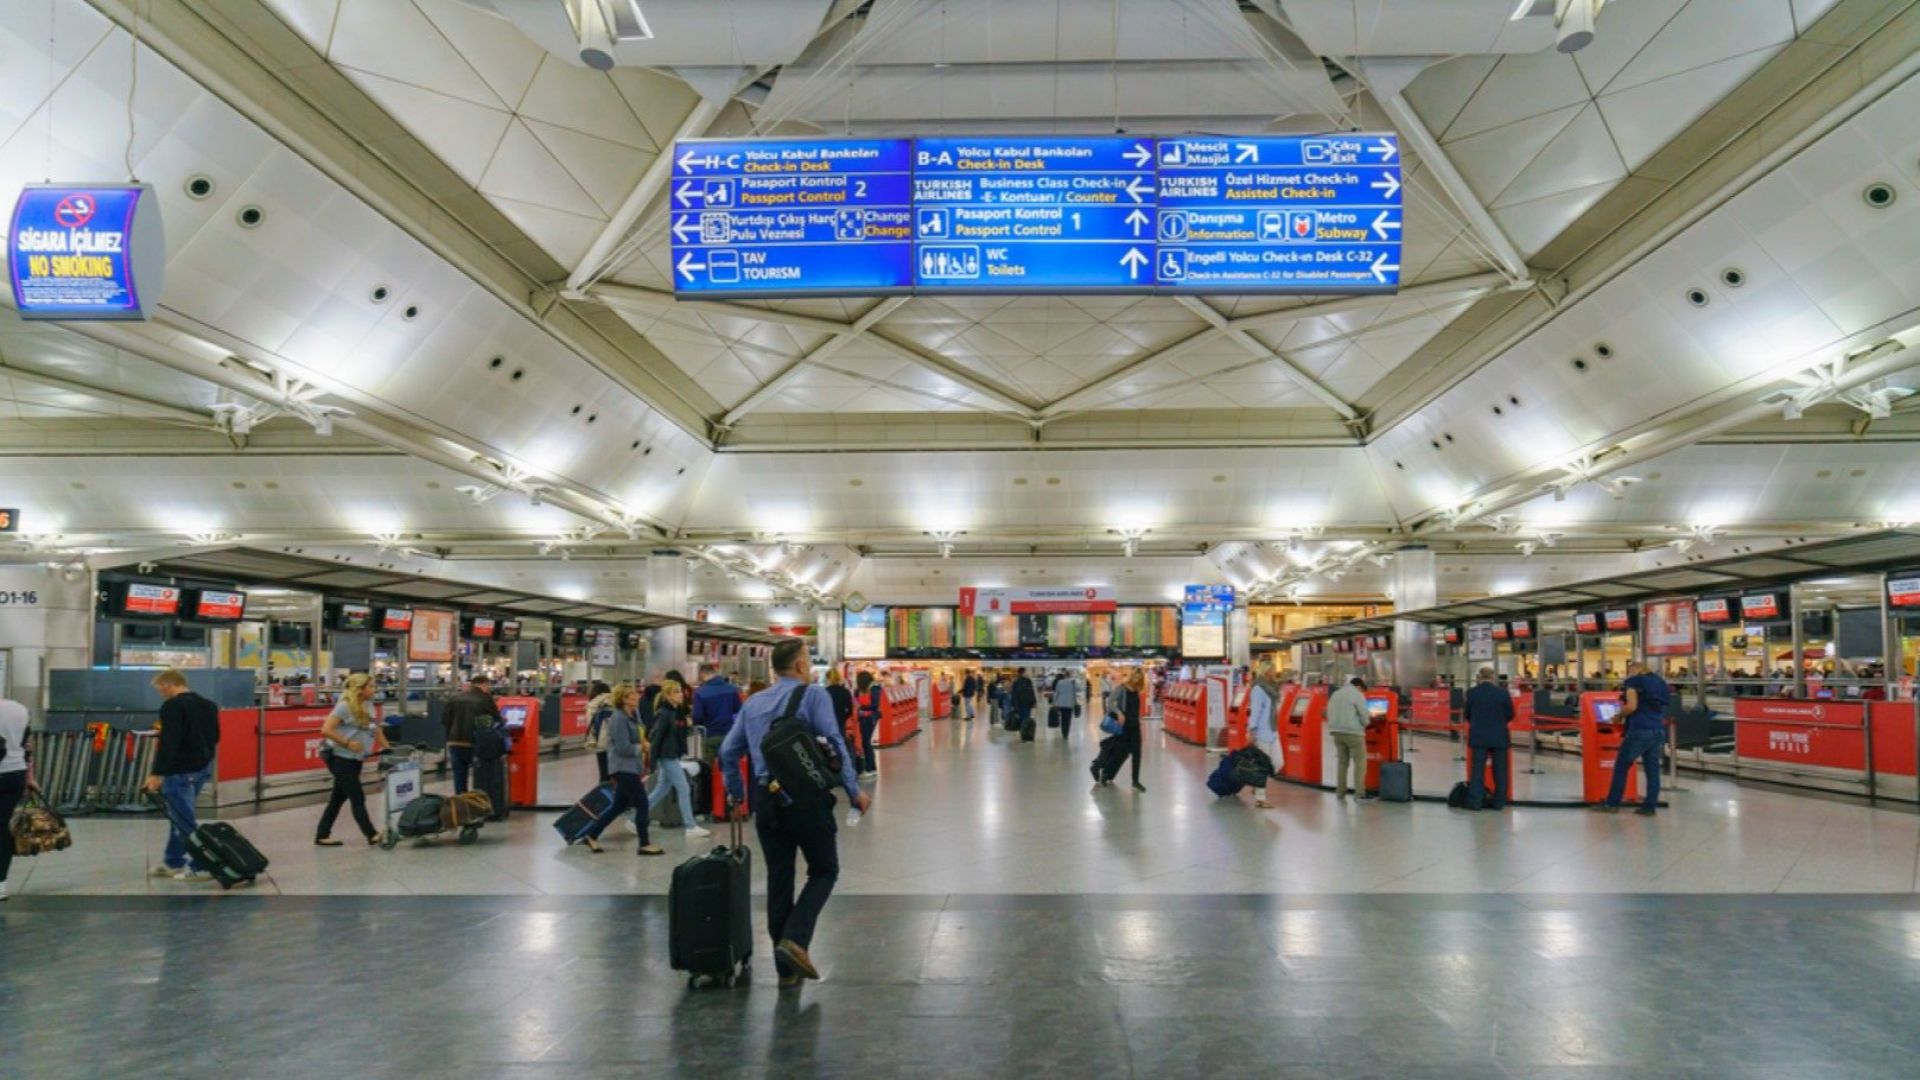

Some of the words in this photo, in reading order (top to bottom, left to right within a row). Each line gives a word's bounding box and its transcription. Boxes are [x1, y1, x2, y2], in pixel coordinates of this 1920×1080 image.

[957, 147, 990, 157] Yolcu
[995, 147, 1030, 157] Kabul
[1187, 142, 1228, 152] Mescit
[745, 151, 778, 160] Yolcu
[782, 149, 817, 159] Kabul
[918, 152, 952, 165] B-A
[1187, 153, 1229, 164] Masjid
[1332, 153, 1357, 163] Exit
[705, 155, 740, 169] H-C
[744, 162, 797, 172] Check-in
[801, 161, 831, 171] Desk
[957, 159, 1011, 169] Check-in
[1015, 158, 1045, 168] Desk
[742, 178, 796, 190] Pasaport
[800, 176, 847, 187] Kontrol
[980, 178, 1034, 189] Business
[1037, 177, 1069, 188] Class
[1072, 177, 1127, 188] Check-in
[1160, 177, 1217, 187] TURKISH
[1225, 172, 1253, 184] Özel
[1256, 173, 1300, 184] Hizmet
[1304, 172, 1359, 184] Check-in
[855, 181, 867, 197] 2
[915, 180, 972, 190] TURKISH
[742, 193, 795, 205] Passport
[799, 191, 846, 203] Control
[914, 189, 972, 200] AIRLINES
[1066, 192, 1117, 202] Counter
[1160, 187, 1218, 197] AIRLINES
[1225, 188, 1277, 199] Assisted
[1281, 188, 1335, 199] Check-in
[864, 211, 910, 224] Change
[955, 208, 1010, 221] Pasaport
[1015, 207, 1062, 219] Kontrol
[1188, 213, 1244, 226] Danışma
[1317, 212, 1356, 223] Metro
[809, 214, 836, 227] Harç
[1072, 213, 1081, 230] 1
[730, 229, 757, 240] Pulu
[760, 227, 805, 240] Veznesi
[864, 226, 910, 238] Change
[955, 224, 1010, 236] Passport
[1013, 223, 1062, 235] Control
[1188, 229, 1255, 239] Information
[1317, 227, 1368, 240] Subway
[742, 252, 766, 264] TAV
[986, 248, 1008, 260] WC
[1188, 251, 1226, 264] Engelli
[1230, 251, 1260, 262] Yolcu
[1316, 251, 1344, 262] Desk
[1347, 251, 1373, 262] C-32
[29, 255, 49, 277] NO
[52, 256, 112, 277] SMOKING
[987, 264, 1025, 275] Toilets
[743, 266, 801, 279] TOURISM
[1296, 271, 1329, 279] Disabled
